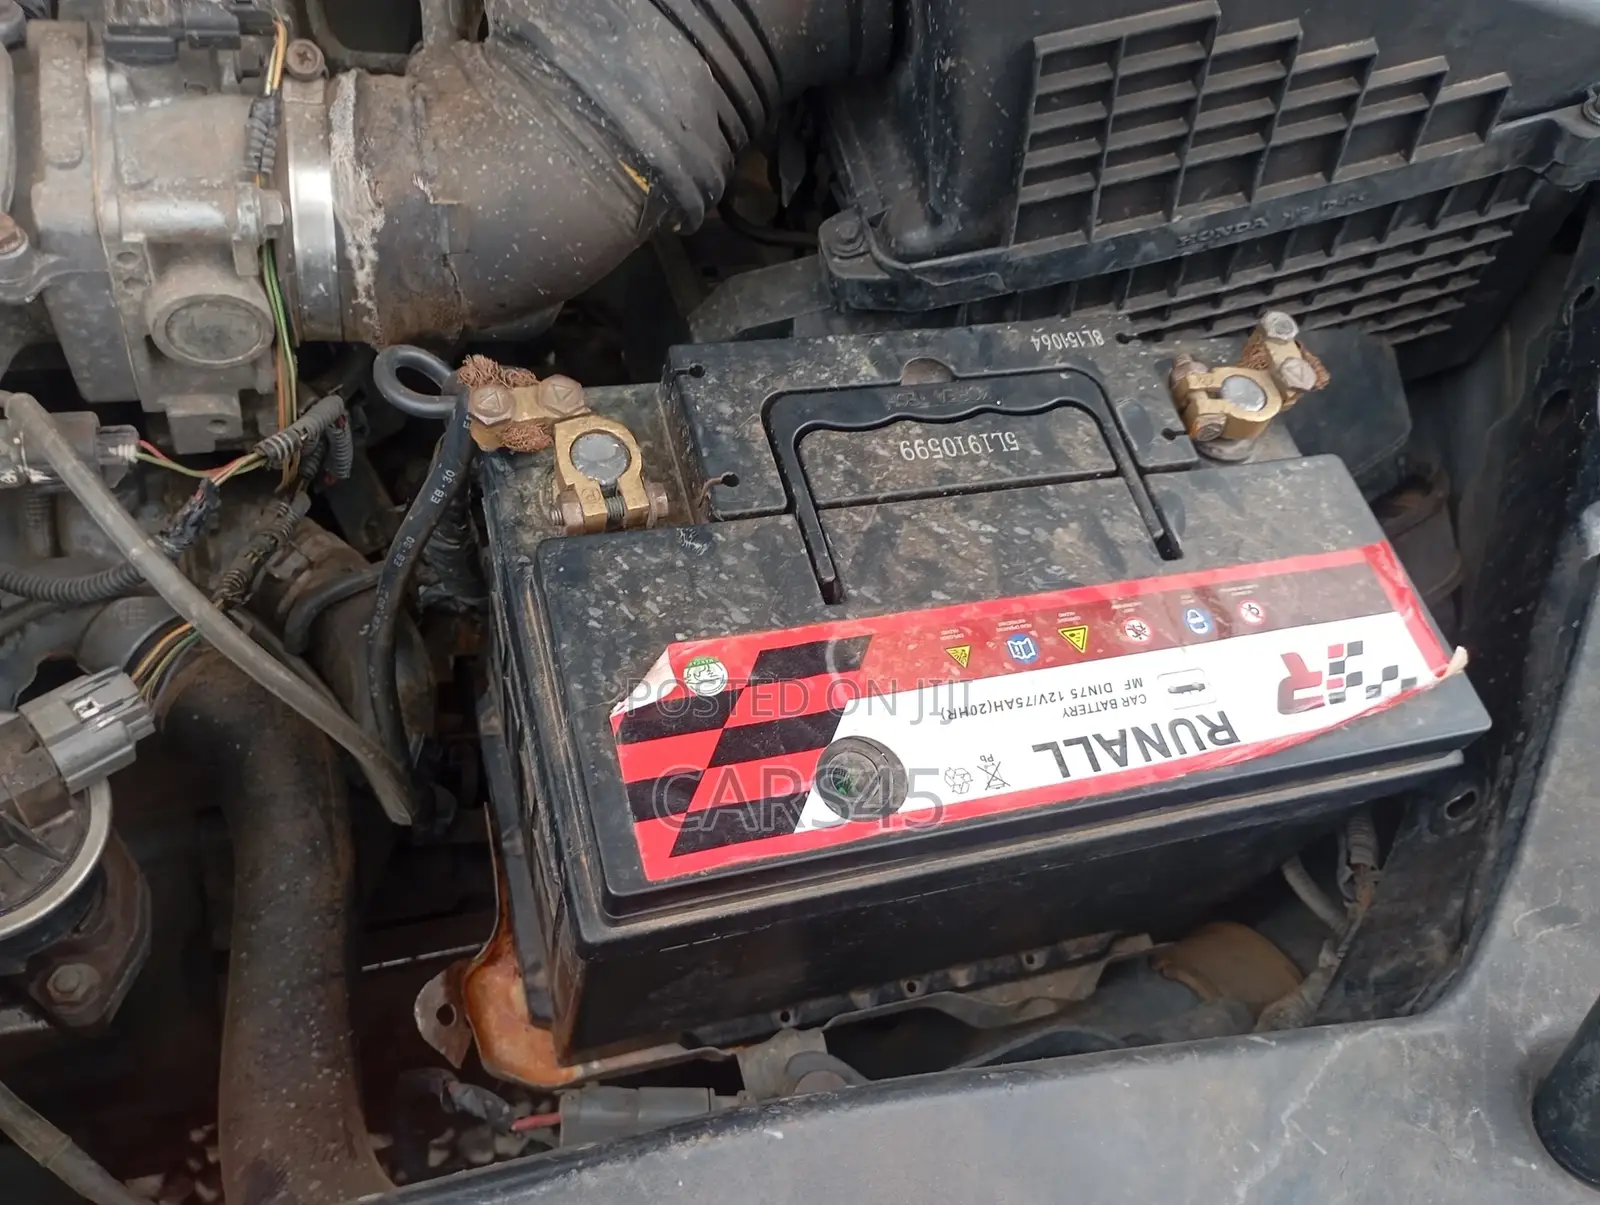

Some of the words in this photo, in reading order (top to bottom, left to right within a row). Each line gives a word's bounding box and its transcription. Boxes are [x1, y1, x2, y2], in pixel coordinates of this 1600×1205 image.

[1177, 217, 1270, 247] HONDA
[899, 431, 1020, 461] 5L1910599
[1070, 682, 1113, 700] DIN75
[1124, 677, 1143, 691] MF
[940, 690, 1064, 721] 12V/75AH(20HR)
[1062, 697, 1118, 719] BATTERY
[1121, 693, 1147, 706] CAR
[1032, 710, 1241, 779] RUNALL
[979, 753, 994, 763] Pb
